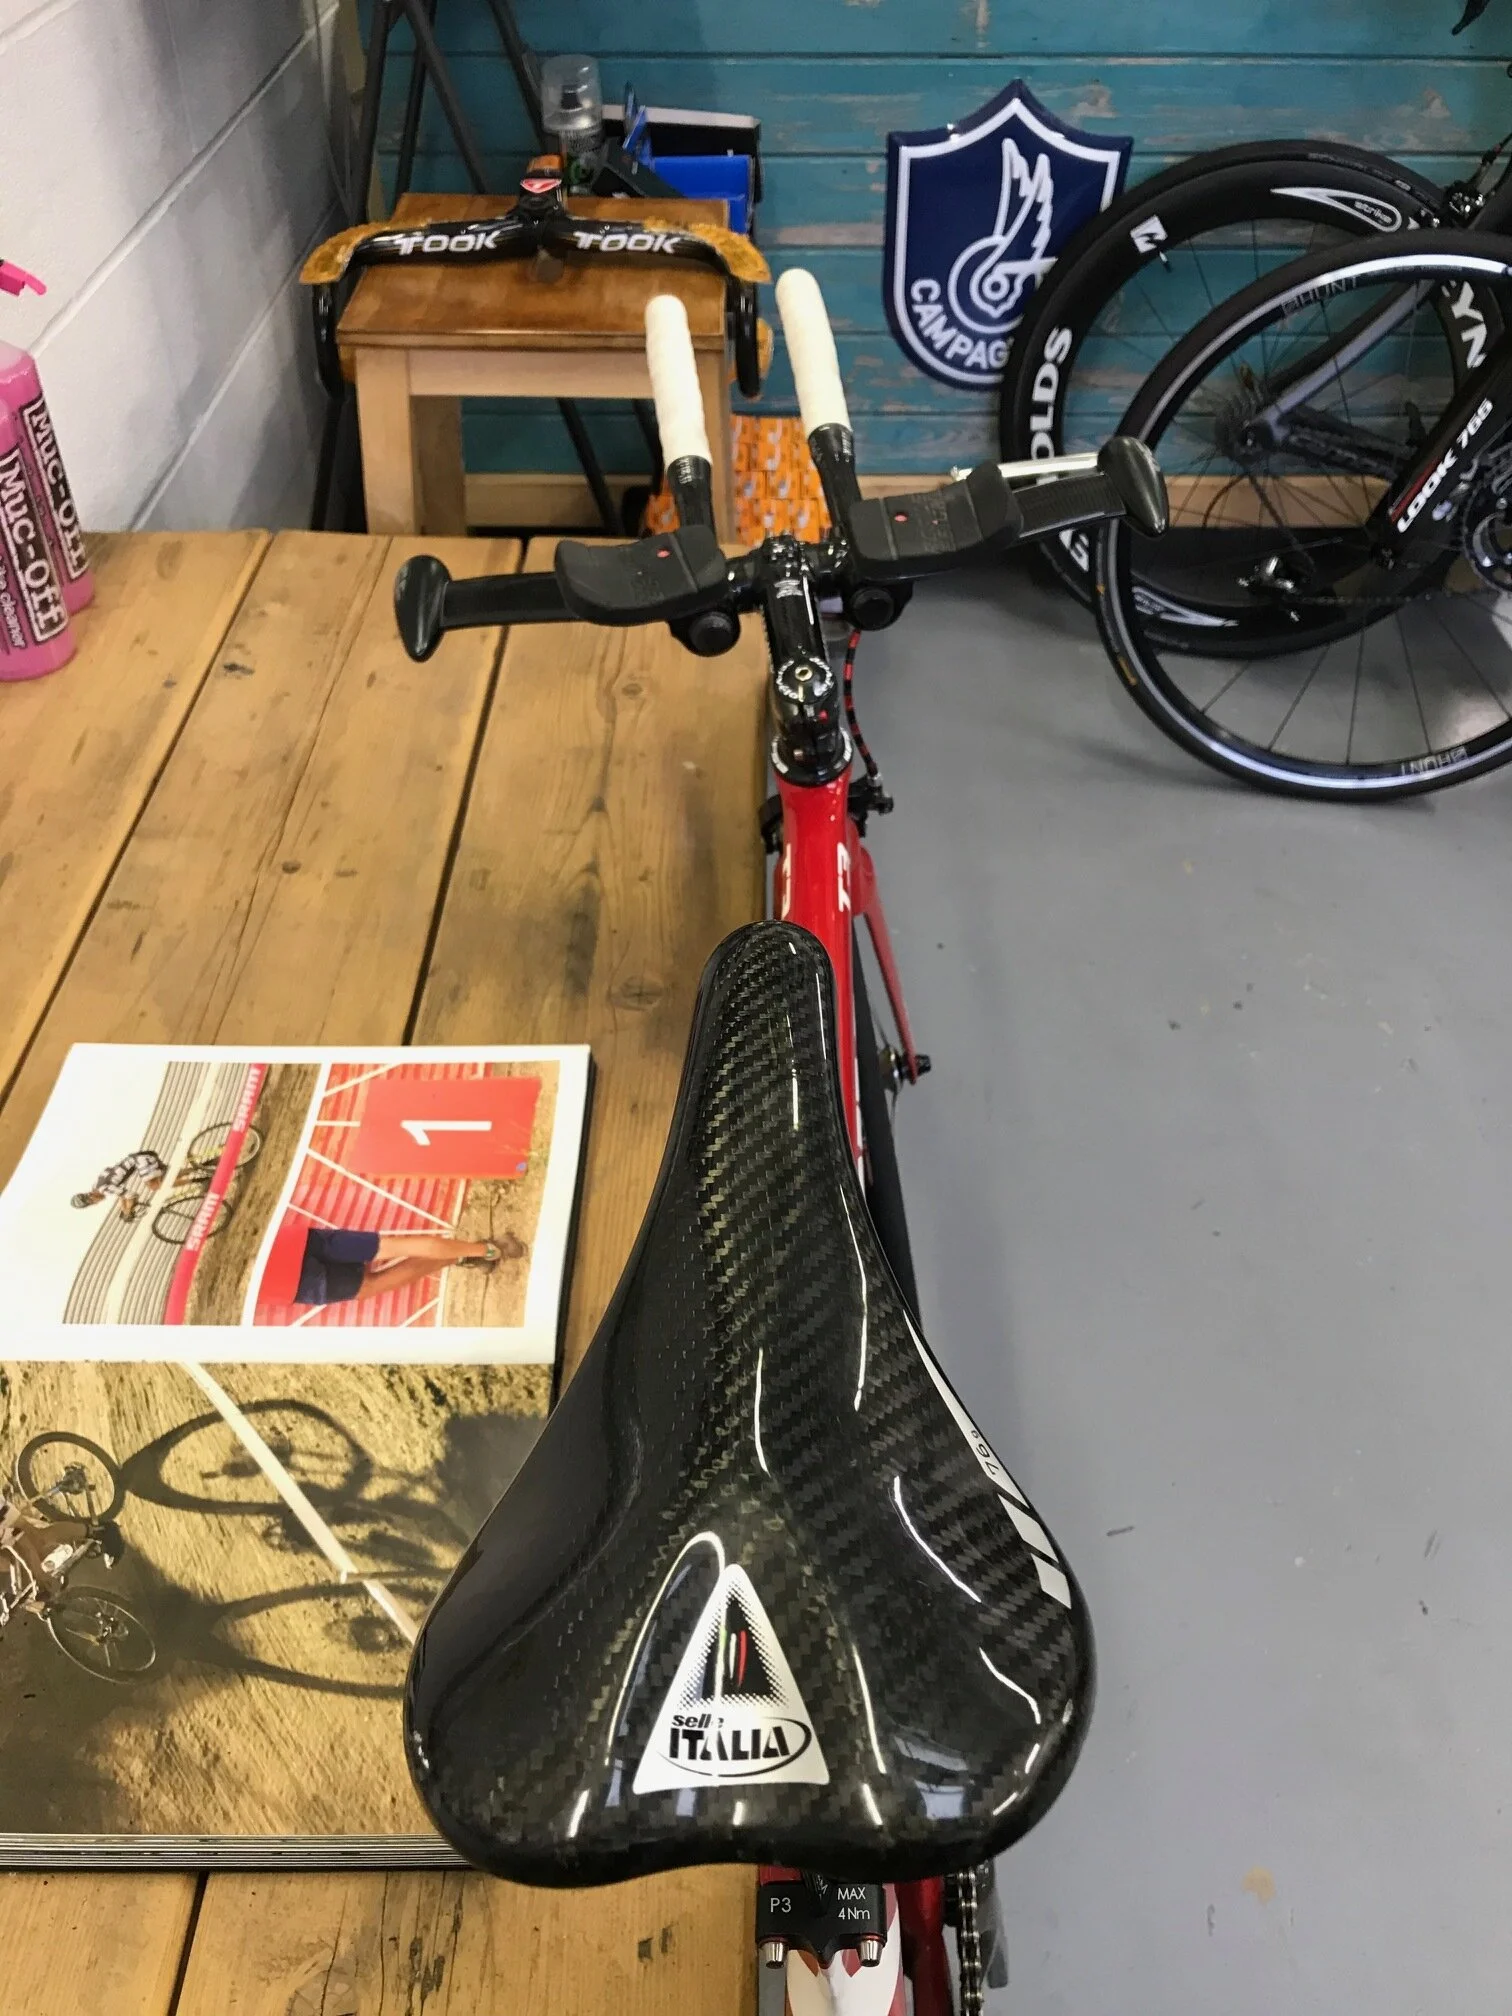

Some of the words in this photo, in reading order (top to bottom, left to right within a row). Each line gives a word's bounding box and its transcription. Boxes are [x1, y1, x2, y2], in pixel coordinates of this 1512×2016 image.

[910, 278, 1010, 370] CAMPAG
[1029, 326, 1073, 460] OLDS
[1397, 448, 1459, 533] LOOK
[187, 1191, 221, 1250] SRAM
[231, 1067, 262, 1133] SRAM
[400, 1120, 493, 1146] 1
[668, 1726, 791, 1761] ITALIA
[770, 1897, 792, 1913] P3
[837, 1887, 866, 1900] MAX
